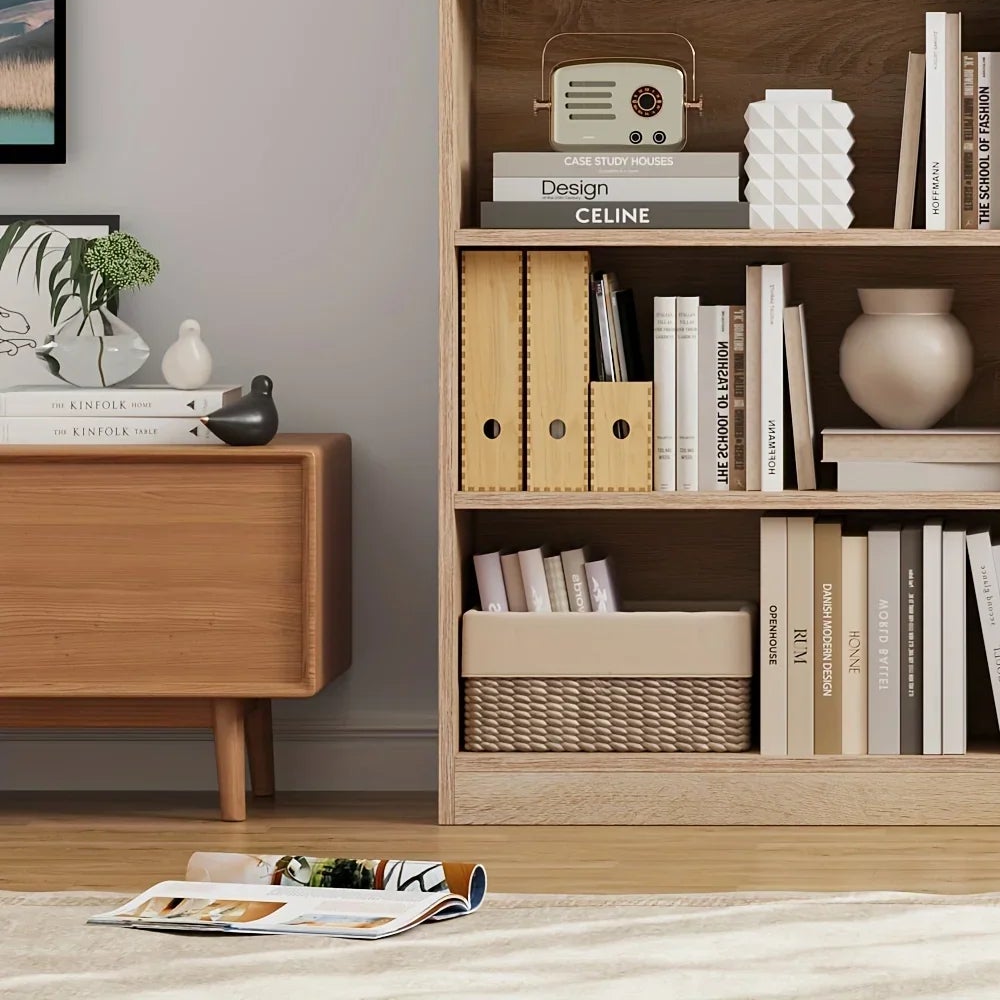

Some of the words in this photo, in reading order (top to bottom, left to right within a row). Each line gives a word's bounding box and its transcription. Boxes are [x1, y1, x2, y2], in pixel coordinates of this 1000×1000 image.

[978, 86, 990, 135] FASHION
[564, 156, 592, 166] CASE
[594, 156, 629, 166] STUDY
[631, 156, 674, 166] HOUSES
[978, 137, 990, 152] OF
[541, 179, 609, 201] Design
[978, 155, 990, 200] SCHOOL
[575, 207, 650, 224] CELINE
[978, 202, 990, 225] THE
[70, 400, 127, 410] KINFOLK
[73, 427, 130, 437] KINFOLK
[823, 583, 833, 619] DANISH
[769, 605, 778, 665] OPENHOUSE
[793, 628, 808, 665] RUM
[823, 620, 833, 661] MODERN
[848, 631, 860, 674] HONNE
[823, 662, 833, 697] DESIGN
